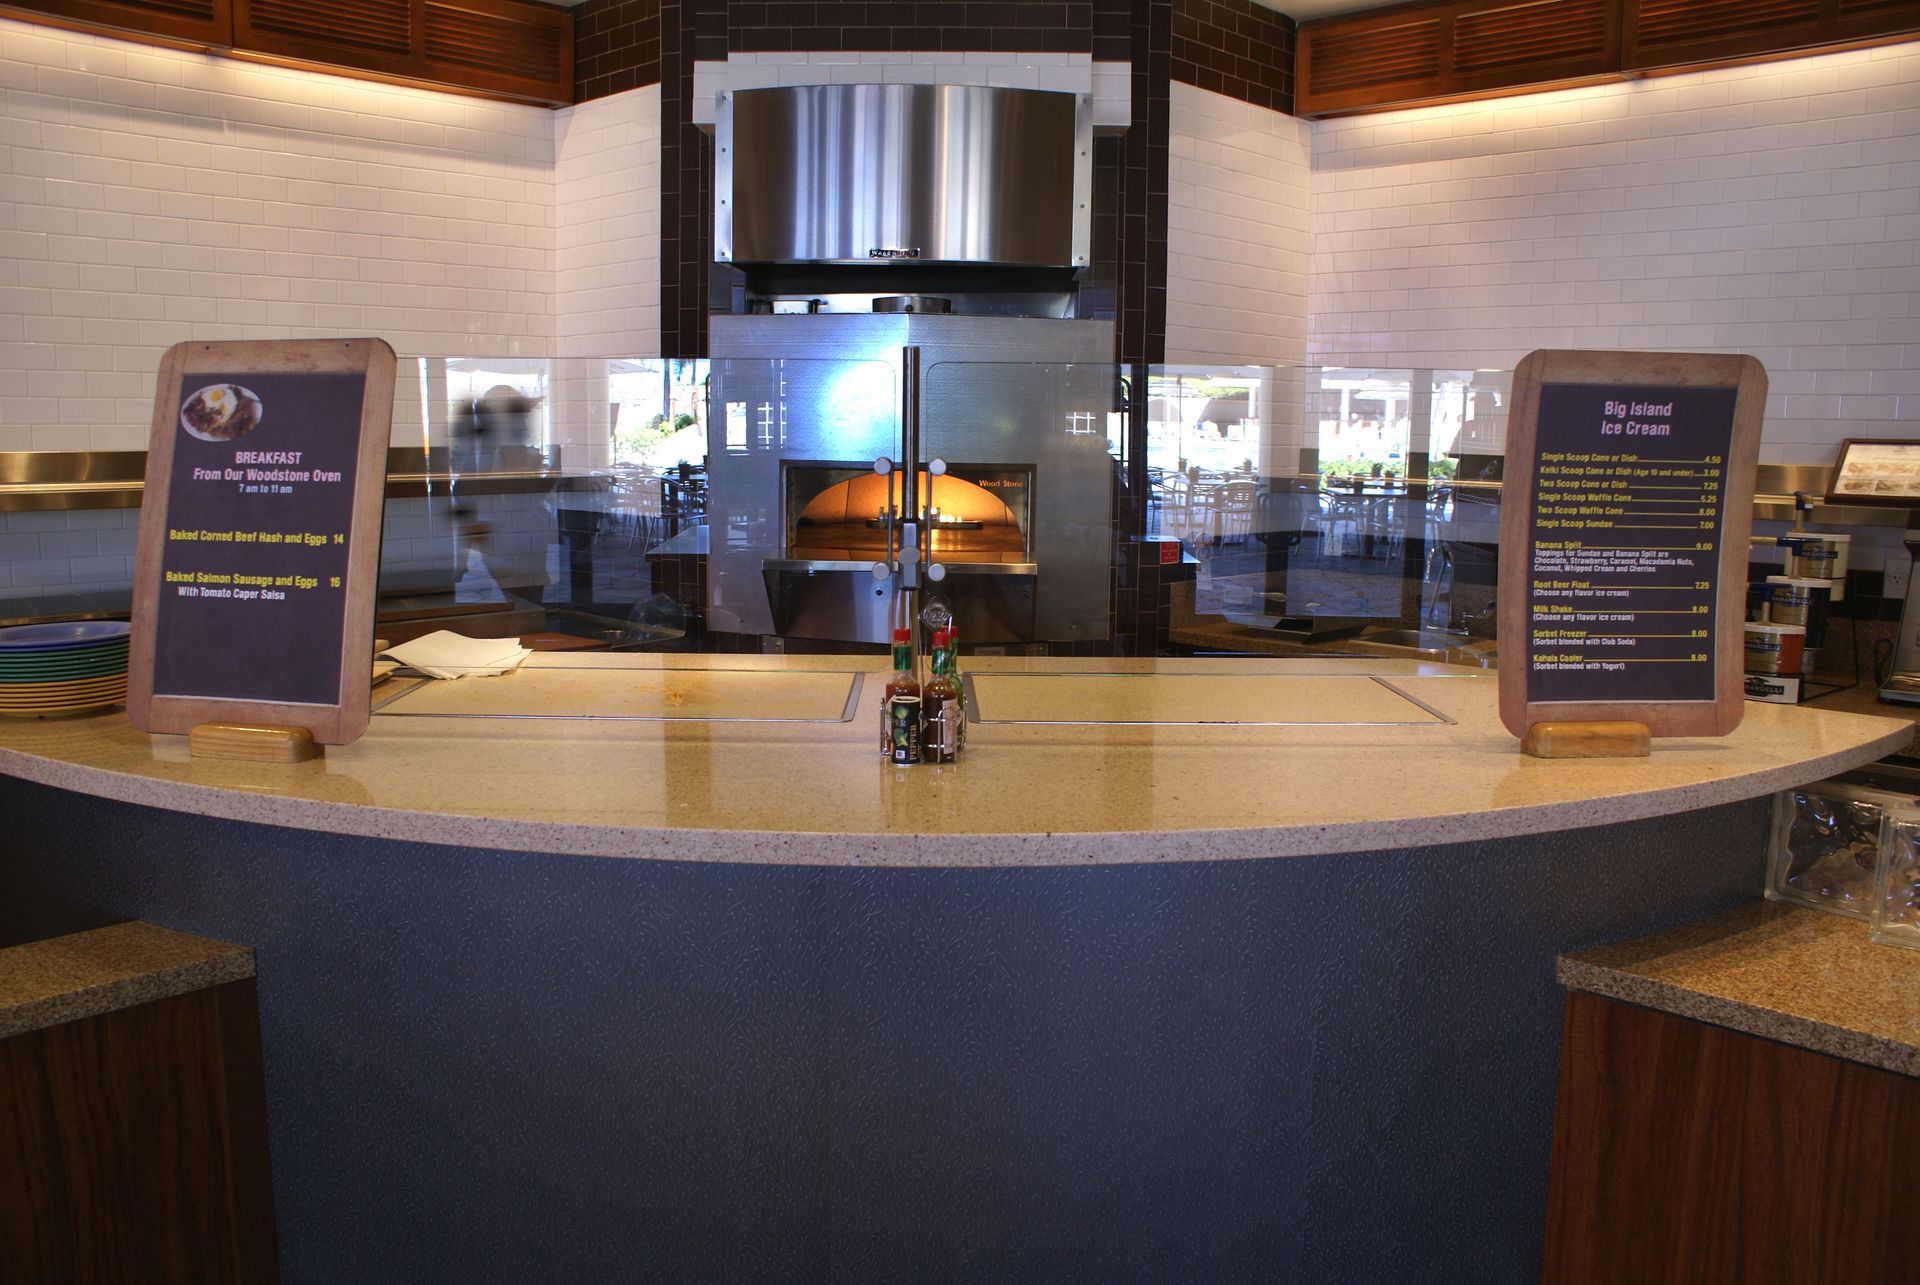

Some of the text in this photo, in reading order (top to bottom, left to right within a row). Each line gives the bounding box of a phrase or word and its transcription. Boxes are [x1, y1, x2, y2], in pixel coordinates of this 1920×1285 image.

[1605, 401, 1672, 417] Big Island
[1601, 421, 1670, 435] Ice Cream
[236, 452, 302, 464] BREAKFAST
[1541, 453, 1564, 462] Single
[1566, 454, 1589, 462] Scoop
[1591, 454, 1609, 462] Cone
[1705, 456, 1721, 464] 4.50
[193, 468, 341, 482] From Our Woodstone Oven
[1560, 467, 1583, 475] Scoop
[1586, 467, 1603, 475] Cone
[239, 484, 244, 492] 7
[261, 485, 269, 493] to
[271, 485, 279, 493] 11
[280, 486, 293, 494] am
[1557, 480, 1579, 489] Scoop
[1582, 480, 1599, 488] Cone
[1704, 482, 1718, 490] 7.25
[1538, 493, 1560, 501] Single
[1563, 493, 1586, 502] Scoop
[1614, 494, 1632, 502] Cone
[1554, 507, 1577, 515] Scoop
[1605, 507, 1623, 515] Cone
[1536, 519, 1559, 528] Single
[1561, 520, 1584, 528] Scoop
[1586, 520, 1612, 528] Sundae
[170, 530, 344, 545] Baked Corned Beef Hash and Eggs 14
[1535, 541, 1562, 549] Banana
[1564, 541, 1581, 550] Split
[1641, 551, 1656, 559] Split
[166, 571, 340, 588] Baked Salmon Sausage and Eggs 16
[1534, 581, 1551, 589] Root
[1553, 581, 1570, 589] Beer
[178, 586, 285, 600] With Tomato Caper Salsa
[1533, 589, 1559, 597] (Choose
[1607, 589, 1629, 597] cream)
[1533, 605, 1548, 613] Milk
[1533, 638, 1557, 646] (Sorbet
